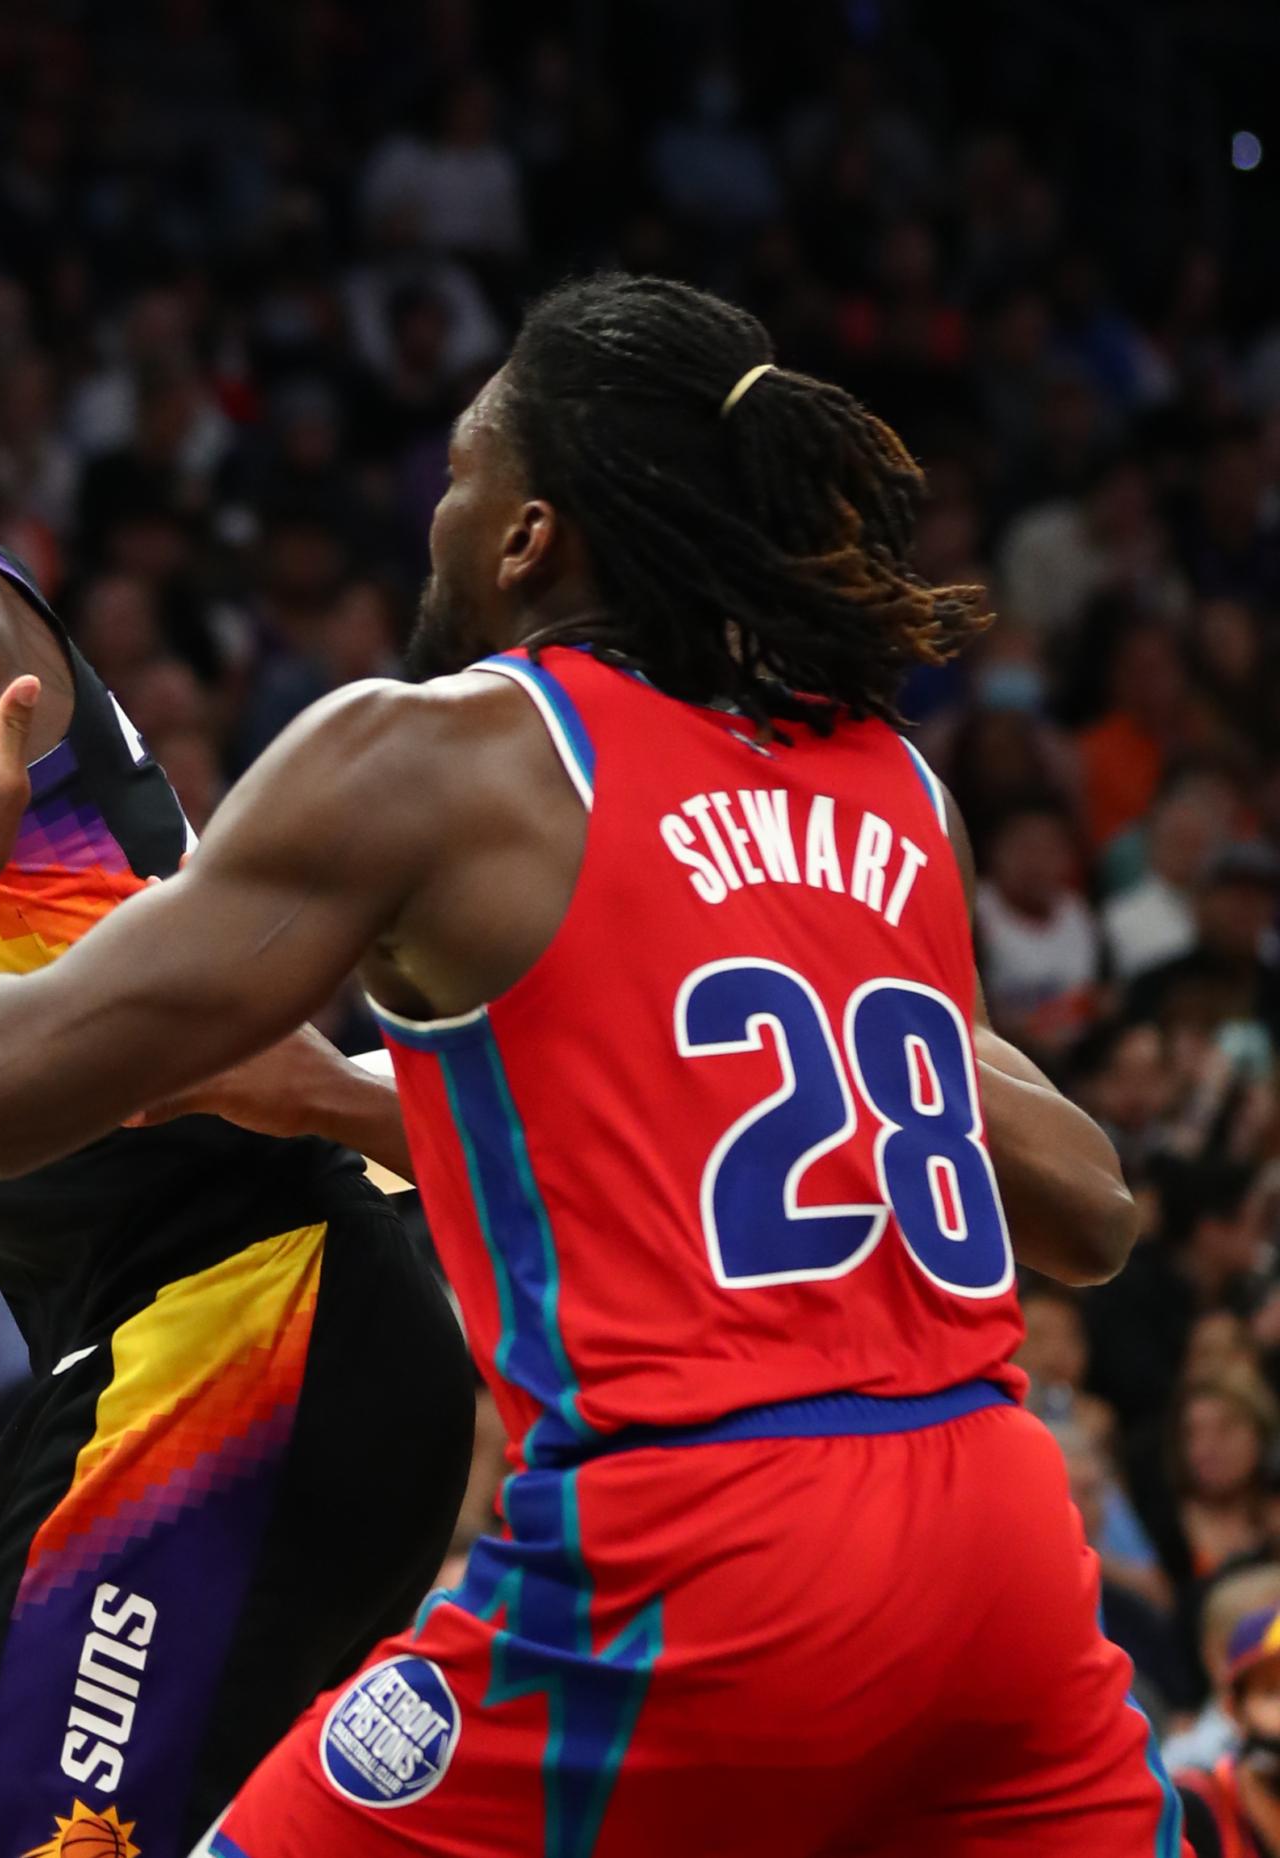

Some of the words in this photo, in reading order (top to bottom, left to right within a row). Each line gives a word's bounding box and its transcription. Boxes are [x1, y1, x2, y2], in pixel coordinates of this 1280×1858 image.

[659, 788, 927, 928] STEWART
[673, 955, 1017, 1299] 28
[60, 1581, 158, 1793] SUNS
[341, 1690, 424, 1781] PISTONS
[365, 1665, 451, 1750] DETROIT
